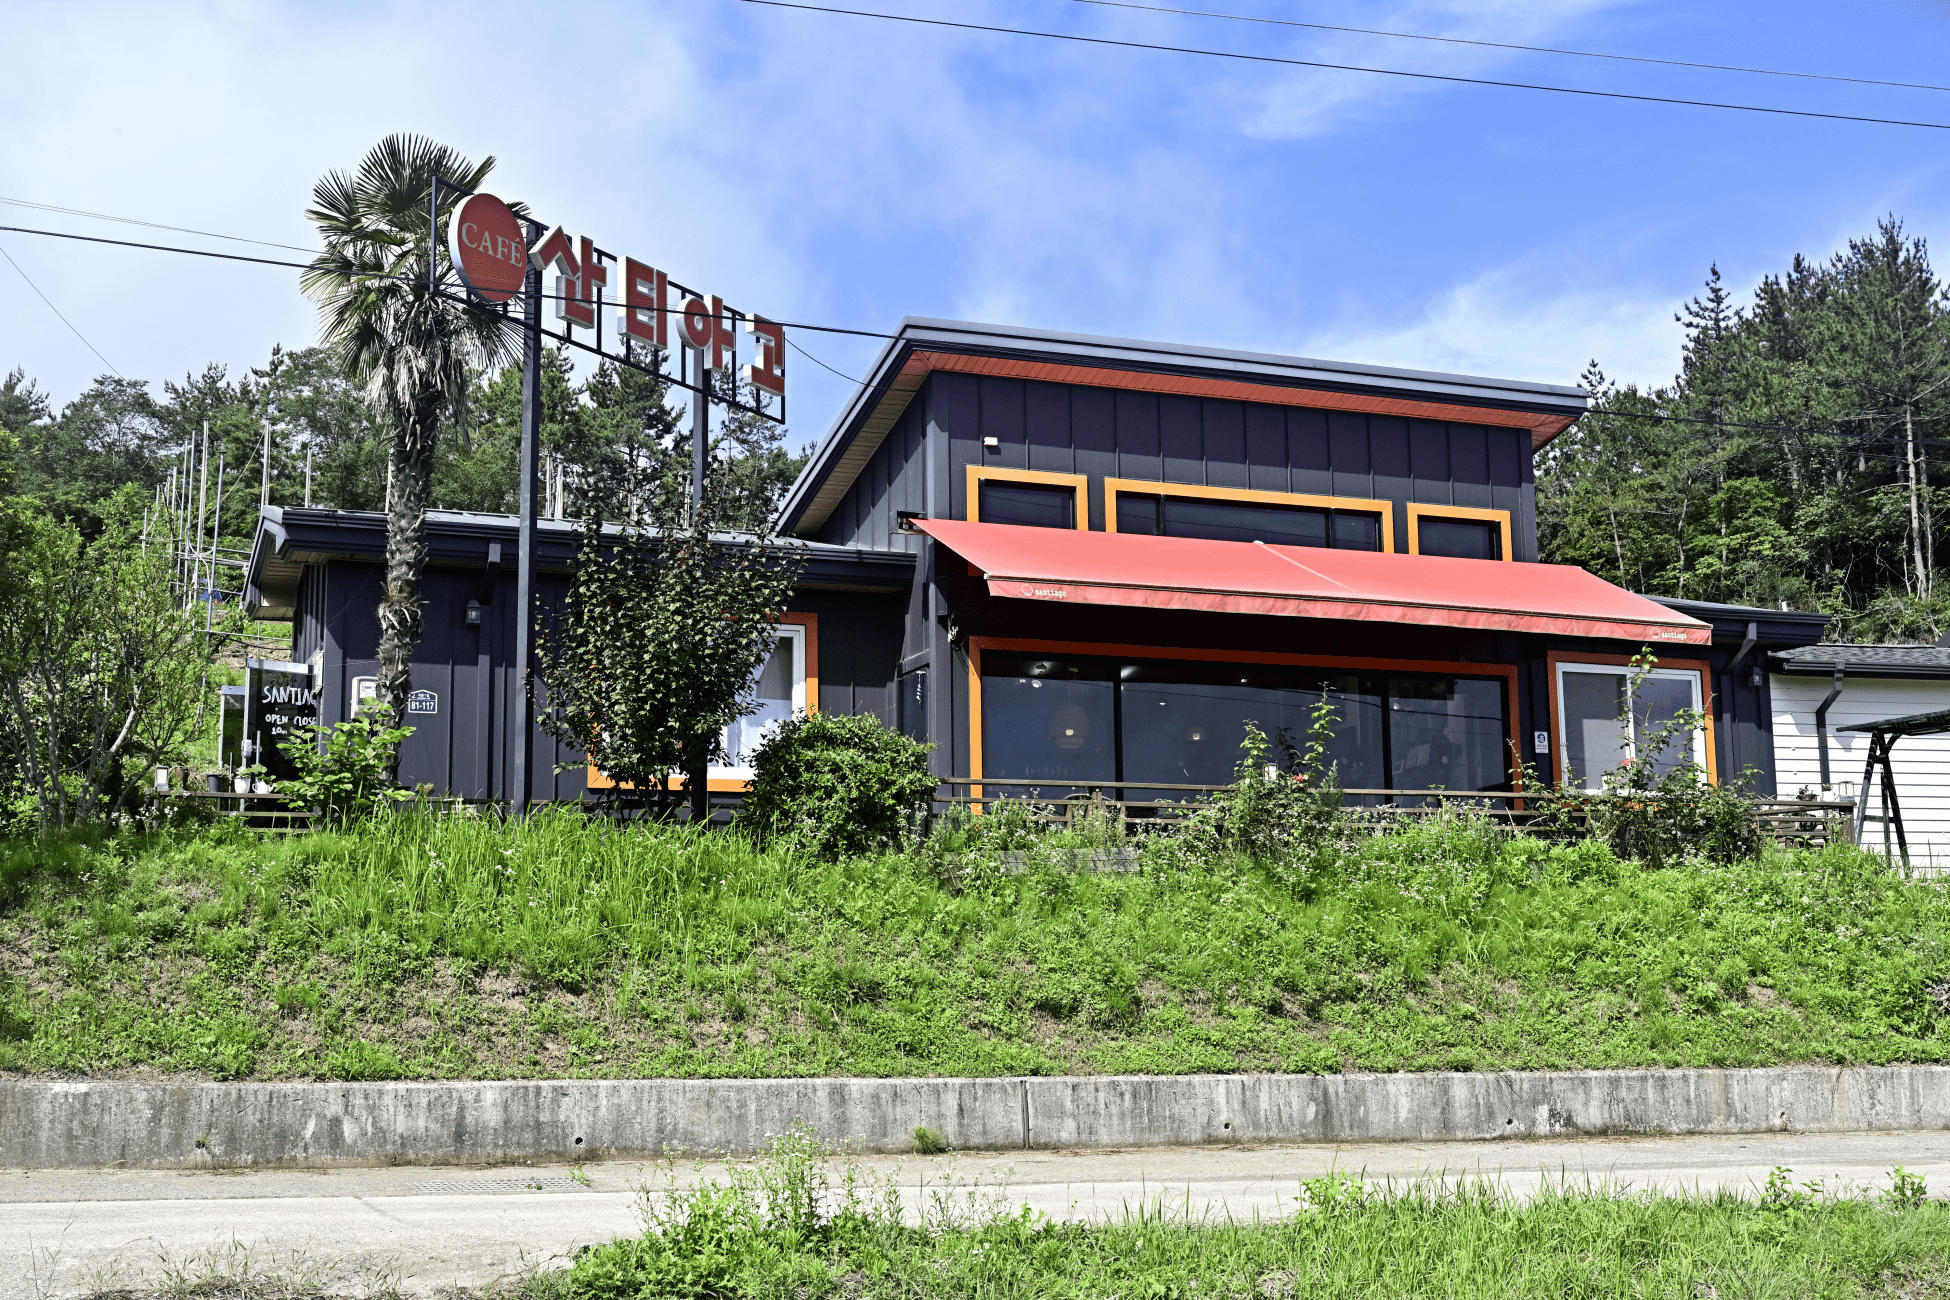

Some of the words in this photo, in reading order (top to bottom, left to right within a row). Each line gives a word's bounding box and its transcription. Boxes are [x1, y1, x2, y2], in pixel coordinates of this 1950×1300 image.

[461, 222, 523, 267] CAFÉ
[528, 225, 786, 397] 산티아고
[1035, 589, 1067, 598] santiago
[1661, 632, 1687, 640] santiago
[262, 686, 317, 707] SANTIAG
[411, 701, 434, 710] 81-117
[265, 714, 288, 724] OPEN
[294, 716, 316, 727] CLOSE
